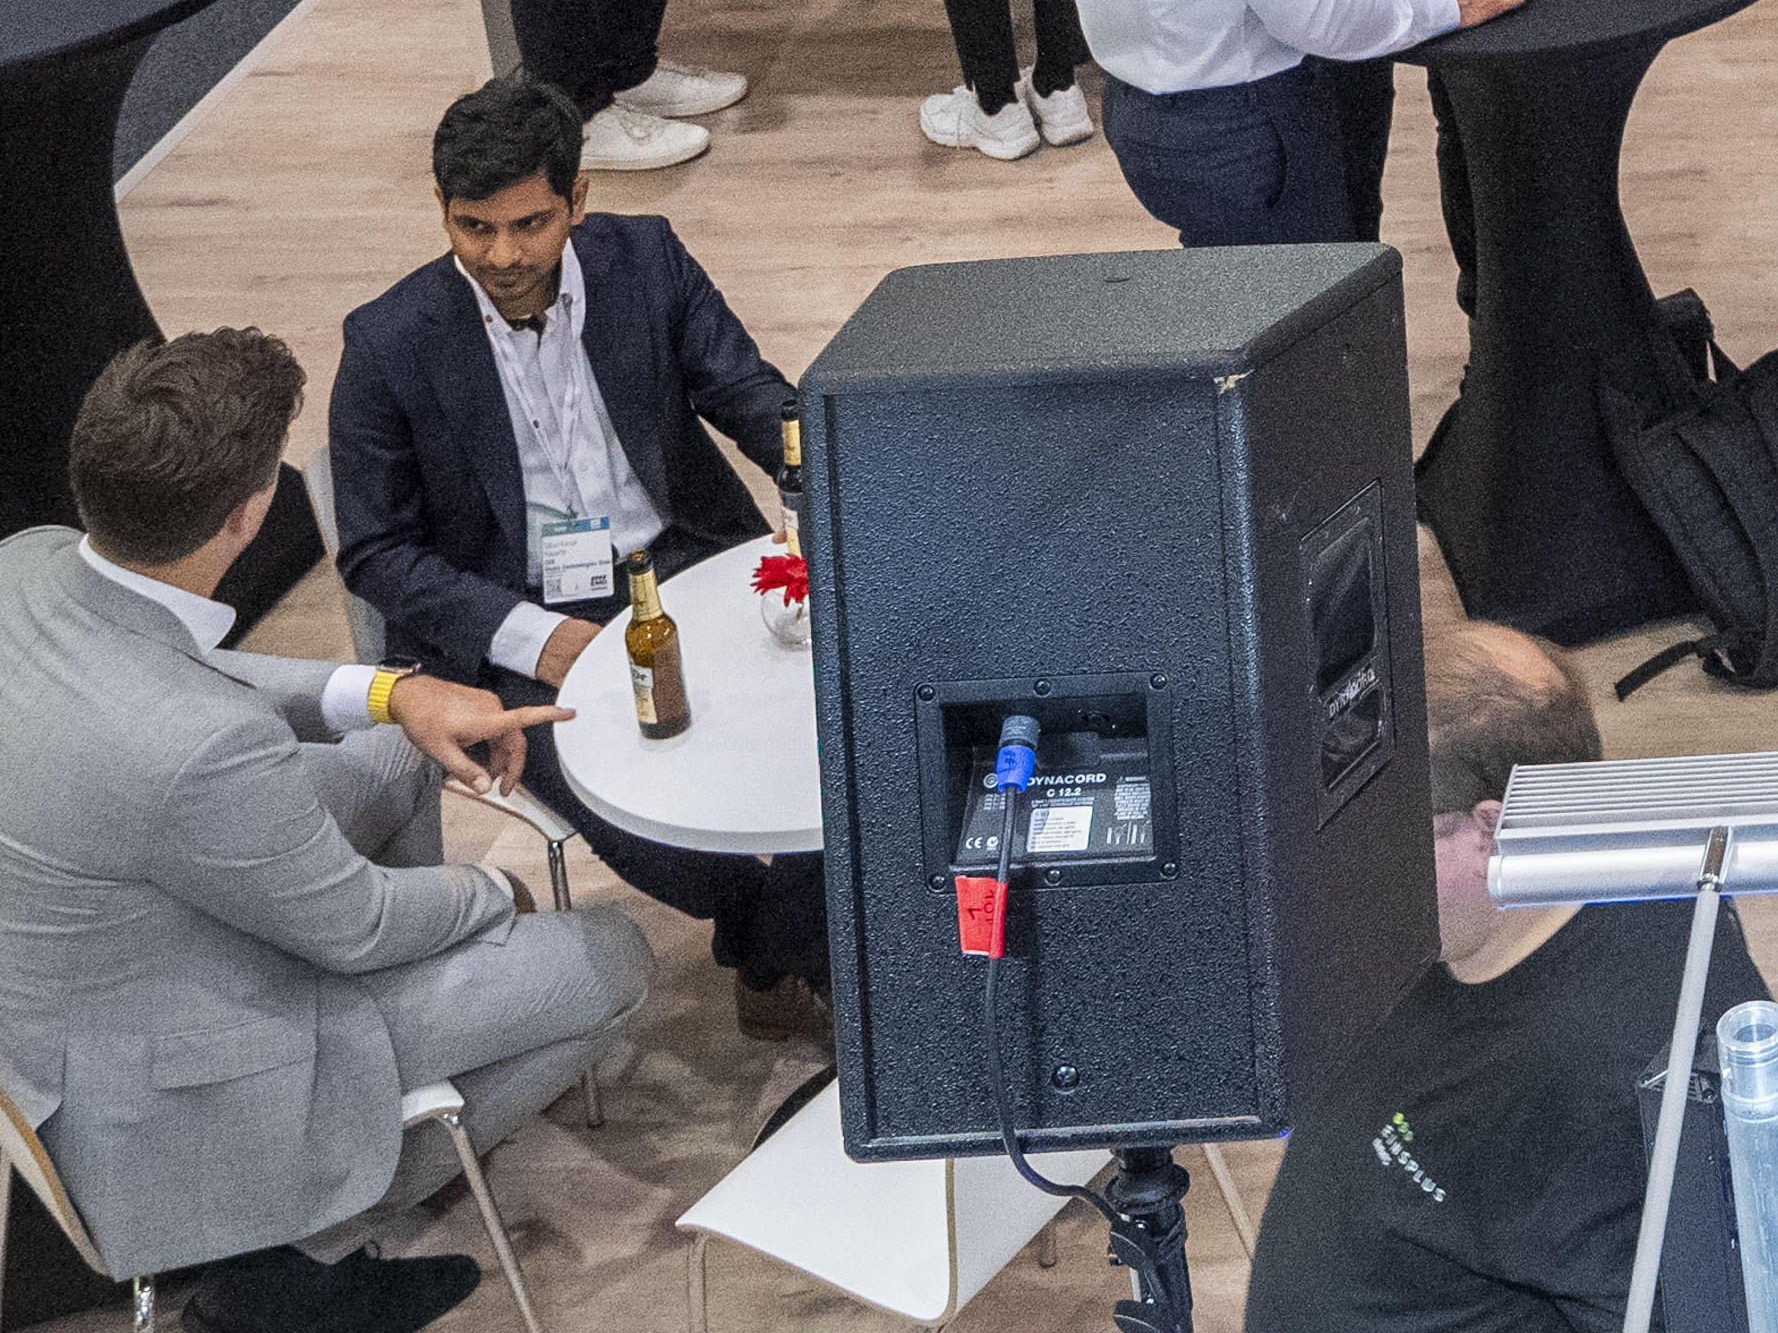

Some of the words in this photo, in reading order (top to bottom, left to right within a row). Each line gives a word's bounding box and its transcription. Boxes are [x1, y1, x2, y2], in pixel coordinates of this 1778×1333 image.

[1028, 772, 1107, 787] DYNACORD
[1046, 788, 1056, 798] C
[1058, 787, 1081, 798] 12.2
